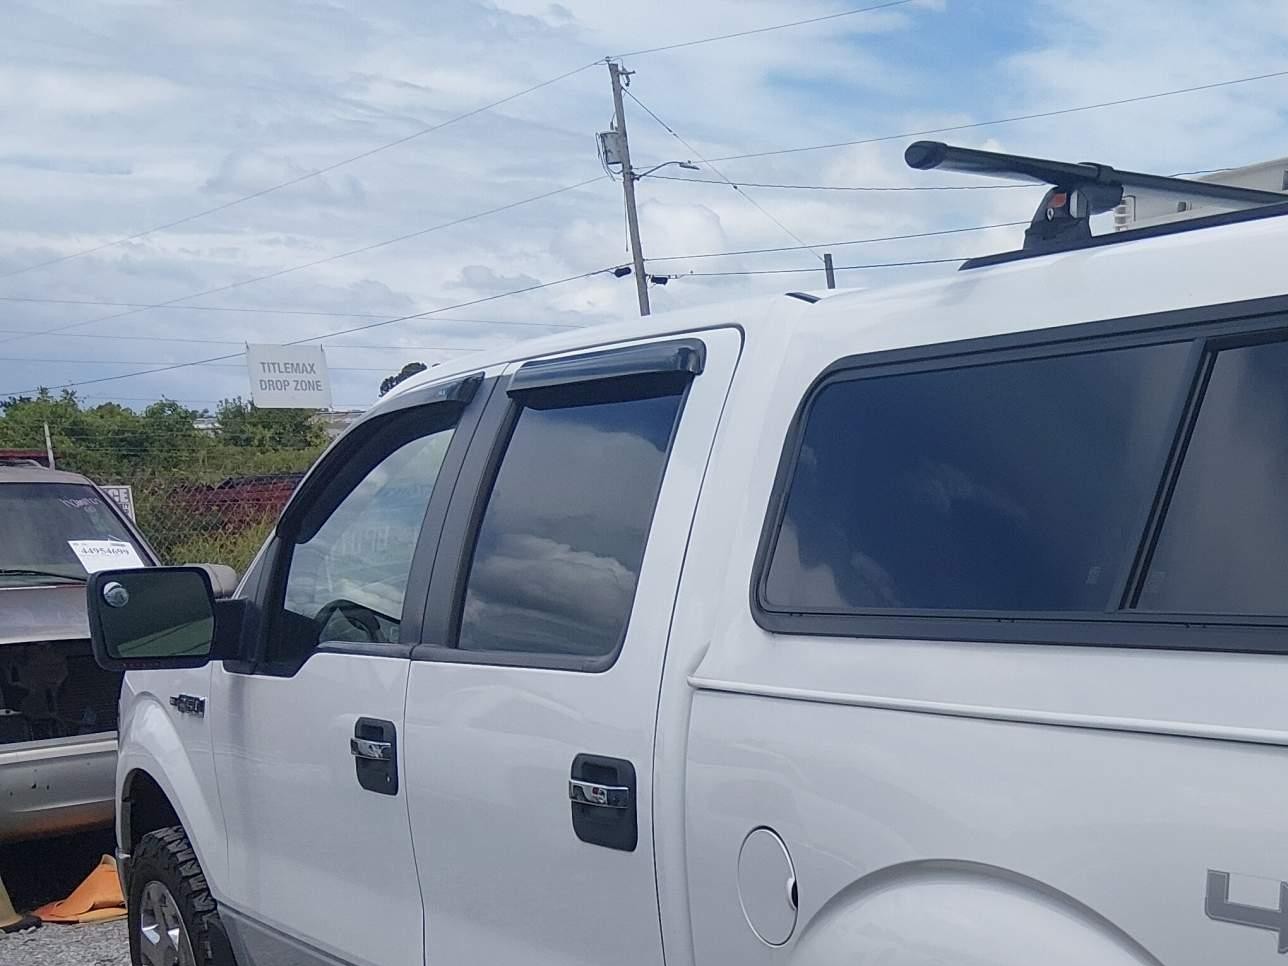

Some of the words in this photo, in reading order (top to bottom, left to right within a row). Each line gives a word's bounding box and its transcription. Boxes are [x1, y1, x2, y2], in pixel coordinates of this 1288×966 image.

[260, 362, 316, 375] TITLEMAX
[259, 379, 290, 392] DROP
[293, 380, 323, 392] ZONE
